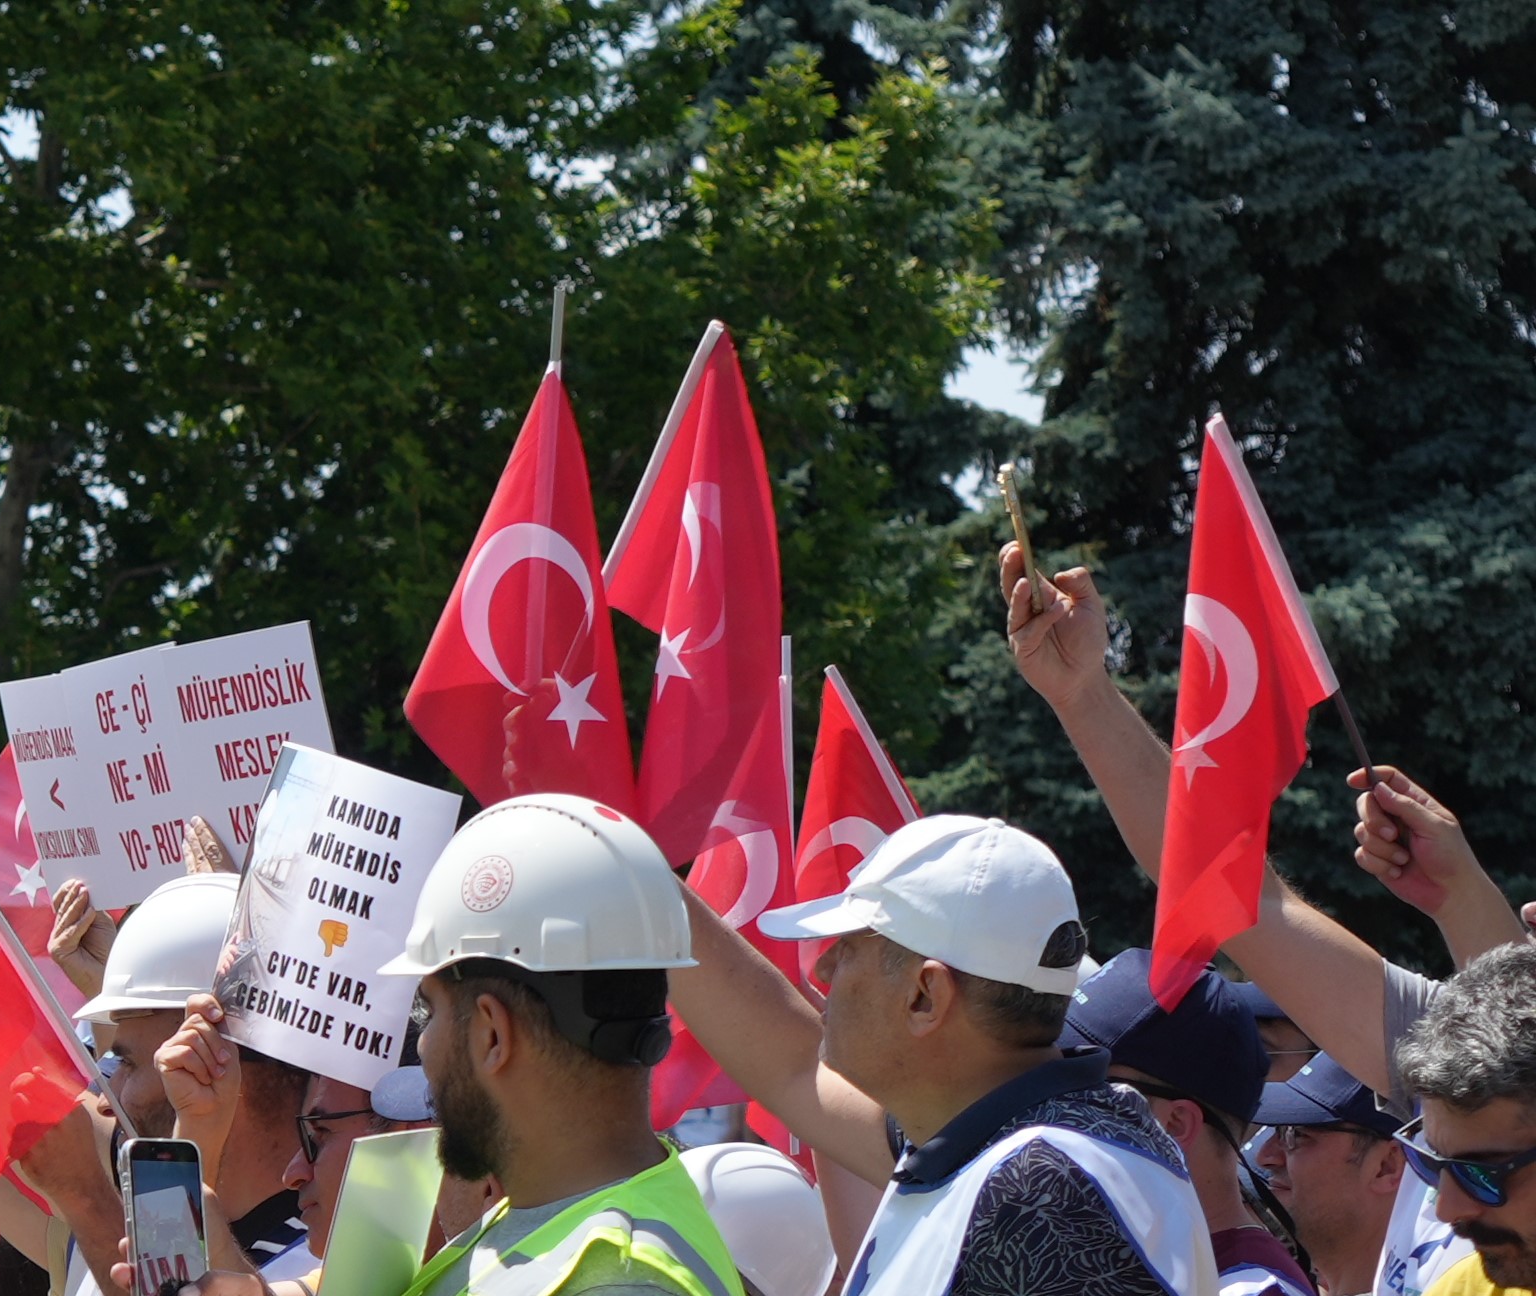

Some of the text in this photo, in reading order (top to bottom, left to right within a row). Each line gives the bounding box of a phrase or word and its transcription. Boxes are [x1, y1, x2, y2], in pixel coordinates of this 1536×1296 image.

[96, 690, 120, 735] GE
[131, 674, 153, 734] Çİ
[177, 658, 313, 724] MÜHENDİSLİK
[106, 759, 135, 804] NE
[143, 743, 172, 796] Mİ
[327, 795, 401, 841] KAMUDA
[306, 832, 401, 885] MÜHENDİS
[308, 877, 375, 920] OLMAK
[327, 971, 372, 1013] VAR,
[237, 982, 393, 1060] CEBİMİZDE YOK!
